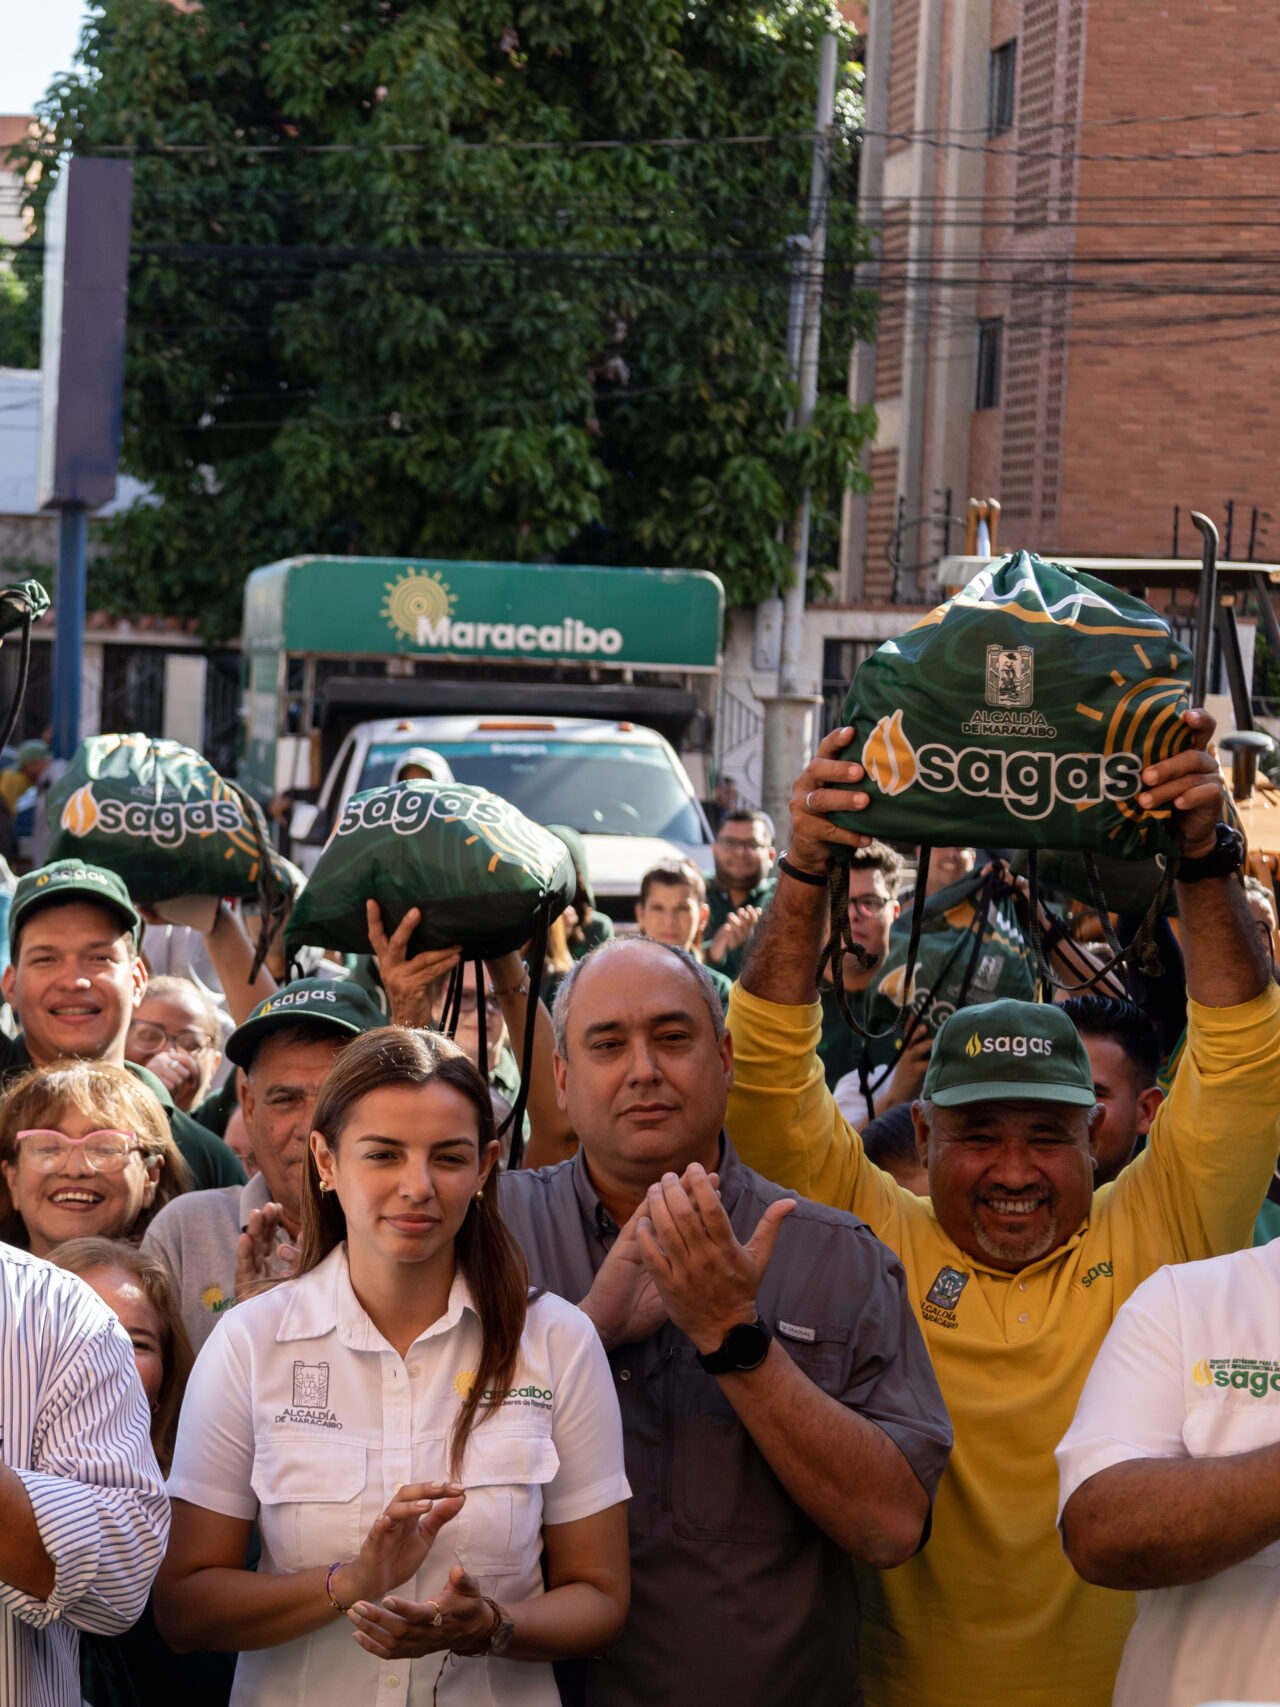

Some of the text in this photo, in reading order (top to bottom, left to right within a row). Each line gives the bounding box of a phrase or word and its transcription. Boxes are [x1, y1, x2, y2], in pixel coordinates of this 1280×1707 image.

[417, 616, 623, 654] Maracaibo
[970, 710, 1048, 727] ALCALDÍA
[962, 722, 1057, 738] DE MARACAIBO
[915, 743, 1143, 820] sagas
[337, 789, 506, 835] sagas
[97, 798, 243, 848] sagas
[271, 990, 336, 1010] sagas
[982, 1036, 1053, 1057] sagas
[275, 1415, 343, 1429] DE MARACAIBO
[283, 1408, 337, 1421] ALCALDÍA
